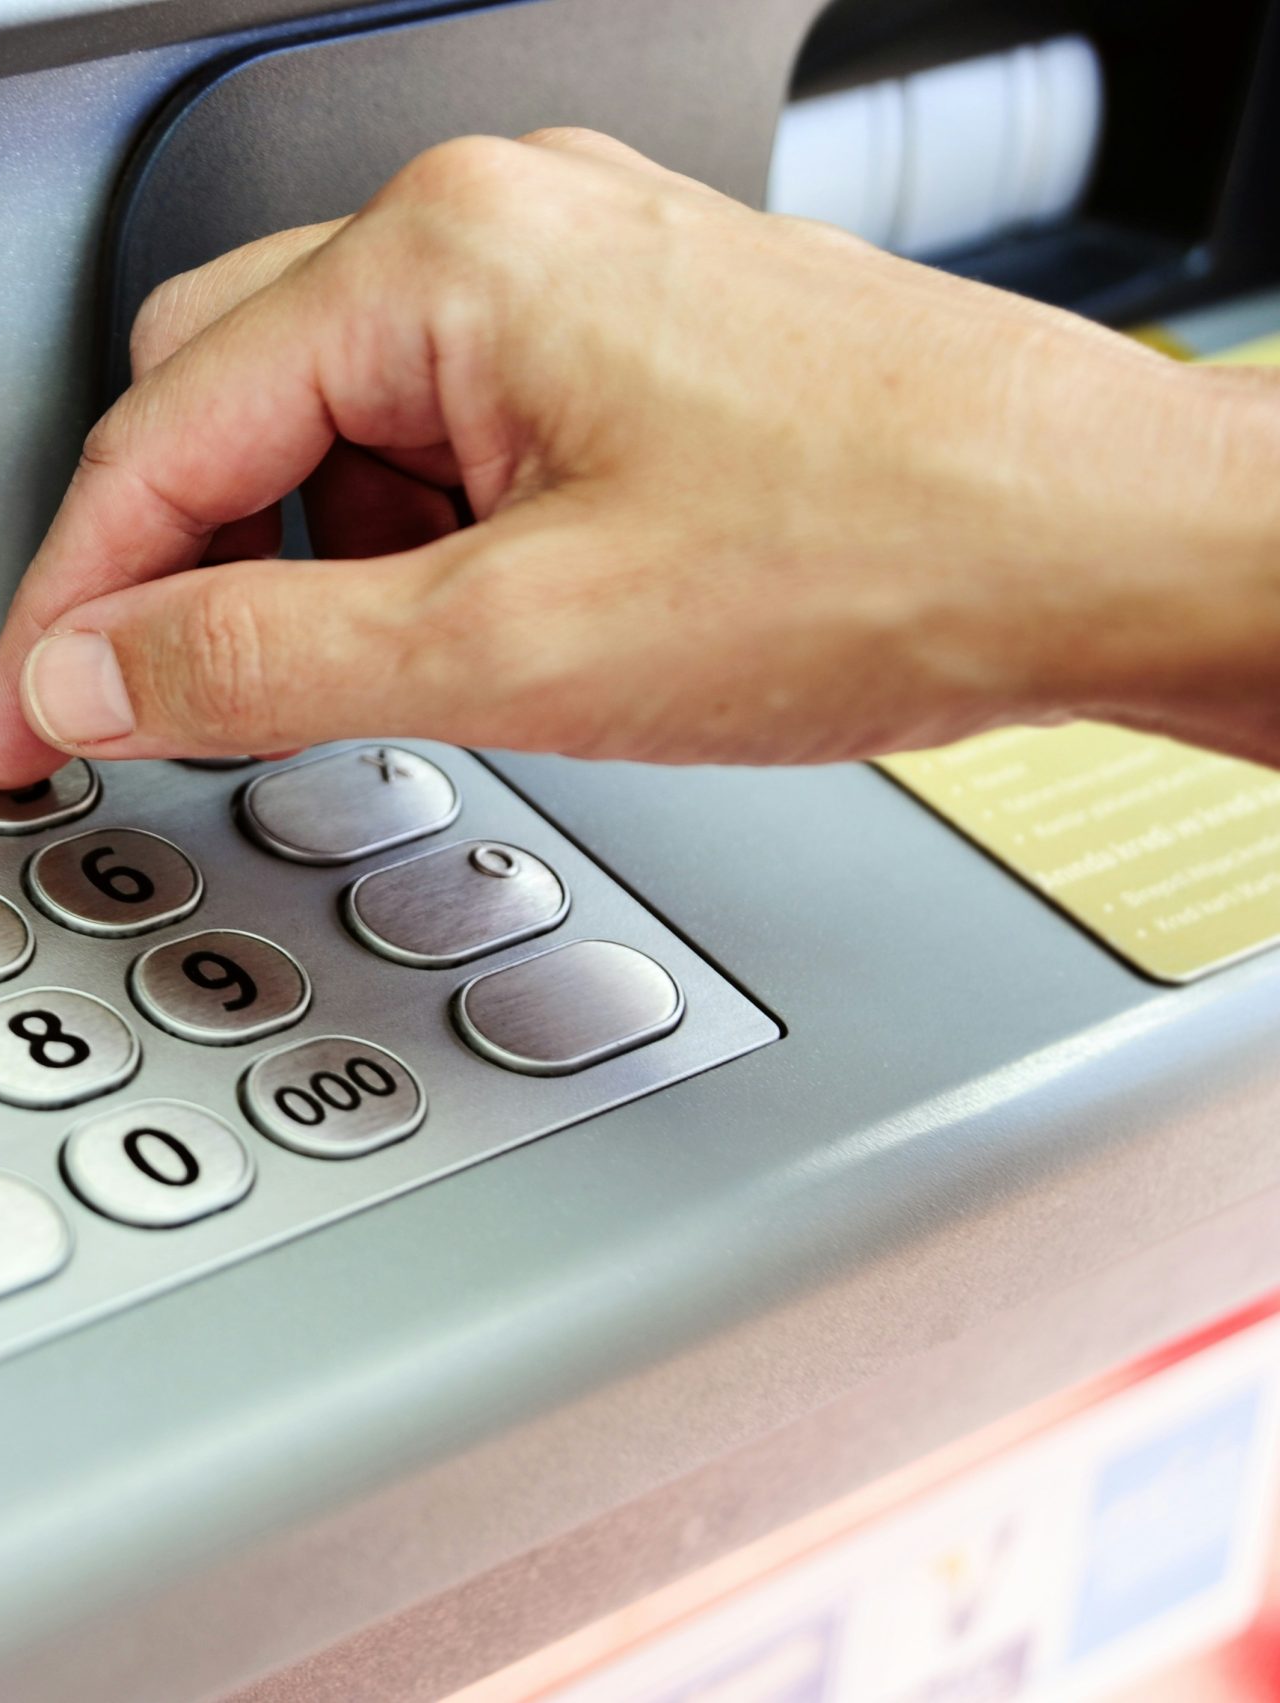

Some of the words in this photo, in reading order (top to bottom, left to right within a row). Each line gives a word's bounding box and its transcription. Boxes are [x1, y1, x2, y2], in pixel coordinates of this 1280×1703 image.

[82, 847, 154, 903] 6
[182, 951, 257, 1011] 9
[8, 1010, 90, 1068] 8
[274, 1057, 397, 1125] 000
[123, 1128, 199, 1186] 0
